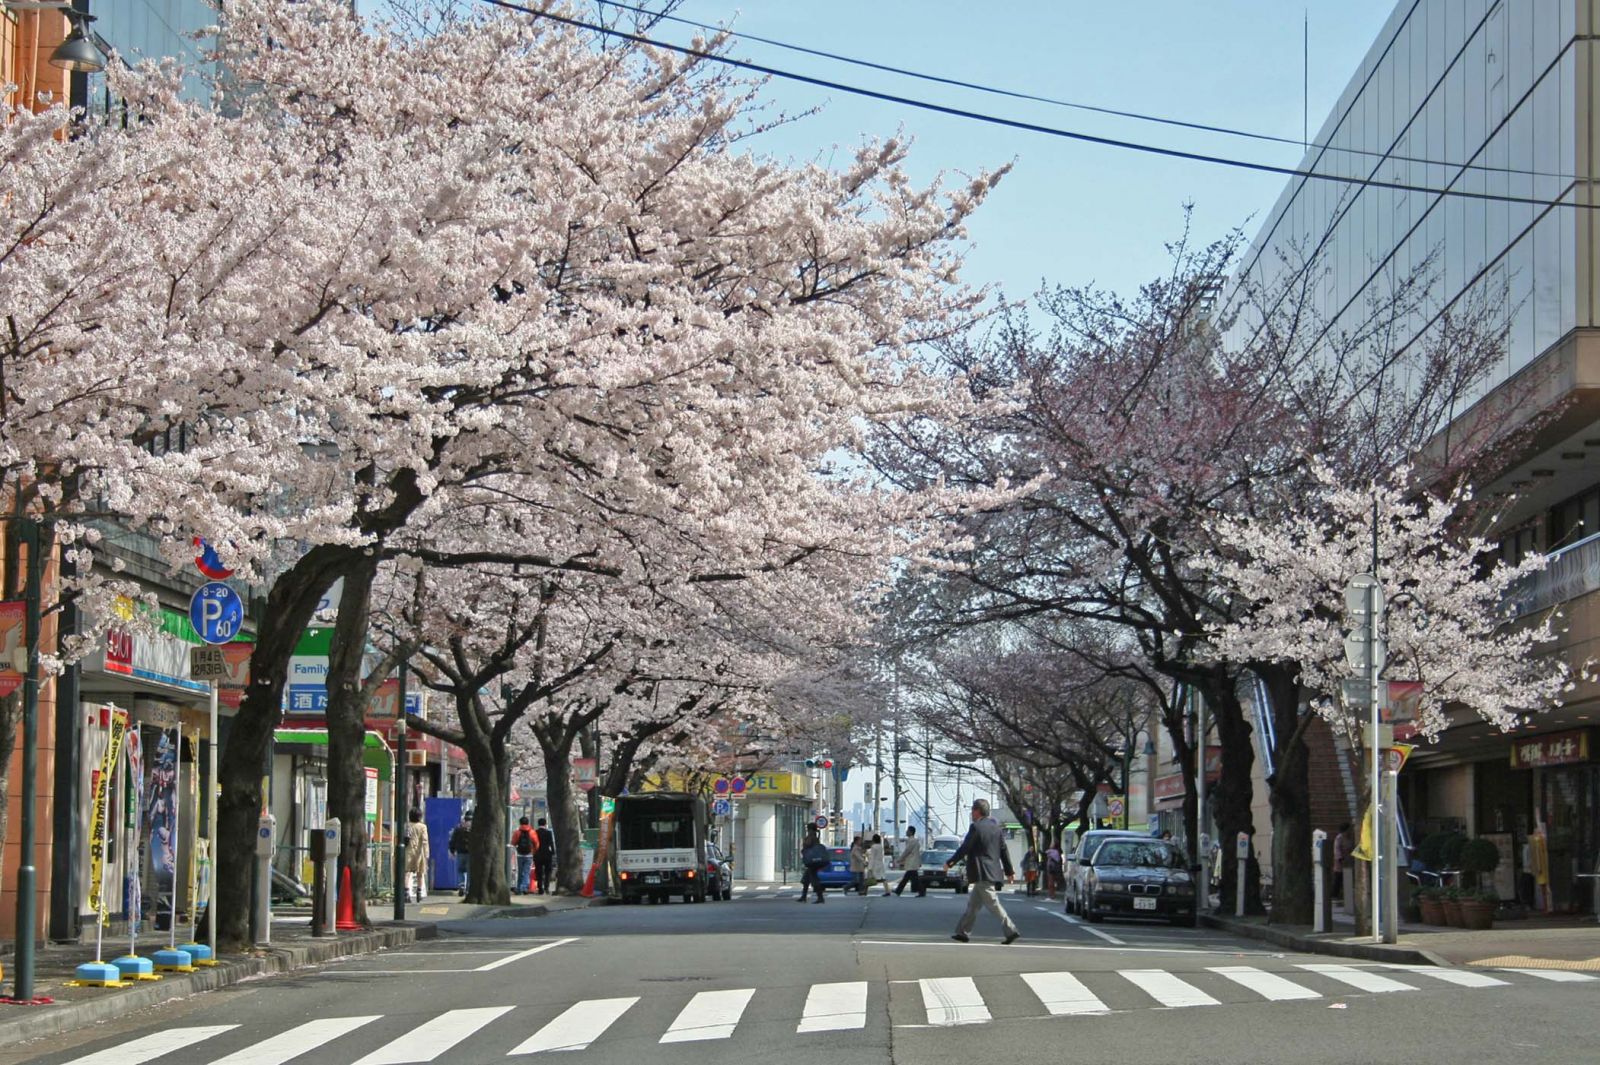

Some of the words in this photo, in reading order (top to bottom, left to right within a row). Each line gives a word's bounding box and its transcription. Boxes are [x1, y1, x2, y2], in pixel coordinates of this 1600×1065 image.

[202, 587, 229, 598] 8-20
[202, 598, 223, 637] P
[294, 693, 313, 708] 酒
